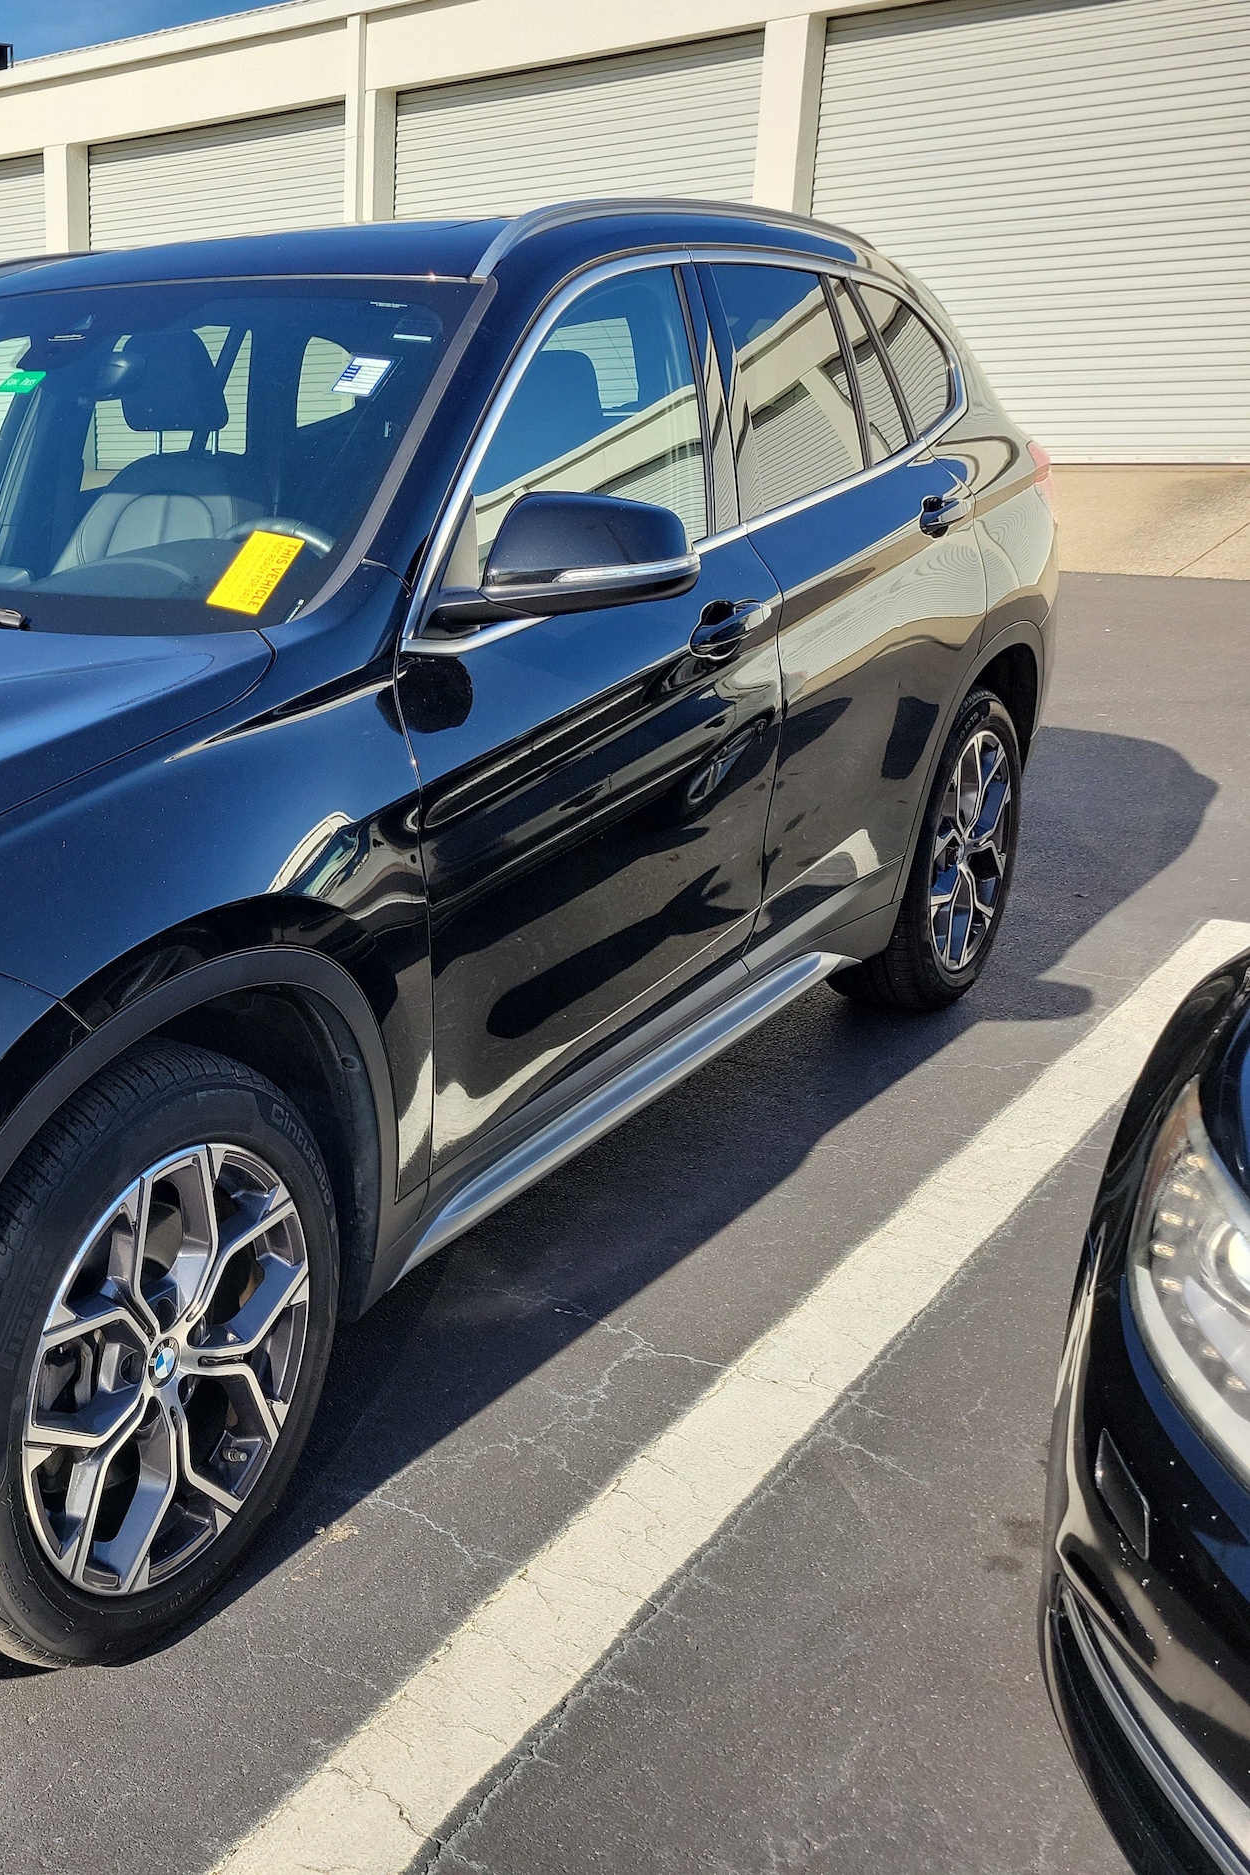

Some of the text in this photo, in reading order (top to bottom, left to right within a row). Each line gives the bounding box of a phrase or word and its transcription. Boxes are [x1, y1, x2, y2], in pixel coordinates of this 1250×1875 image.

[235, 540, 285, 604] NOT READY FOR SALE
[274, 542, 299, 566] THIS
[246, 565, 283, 608] VEHICLE
[271, 1103, 331, 1206] Cinturato
[149, 1338, 176, 1366] BMW
[0, 1562, 31, 1614] OUTSIDE
